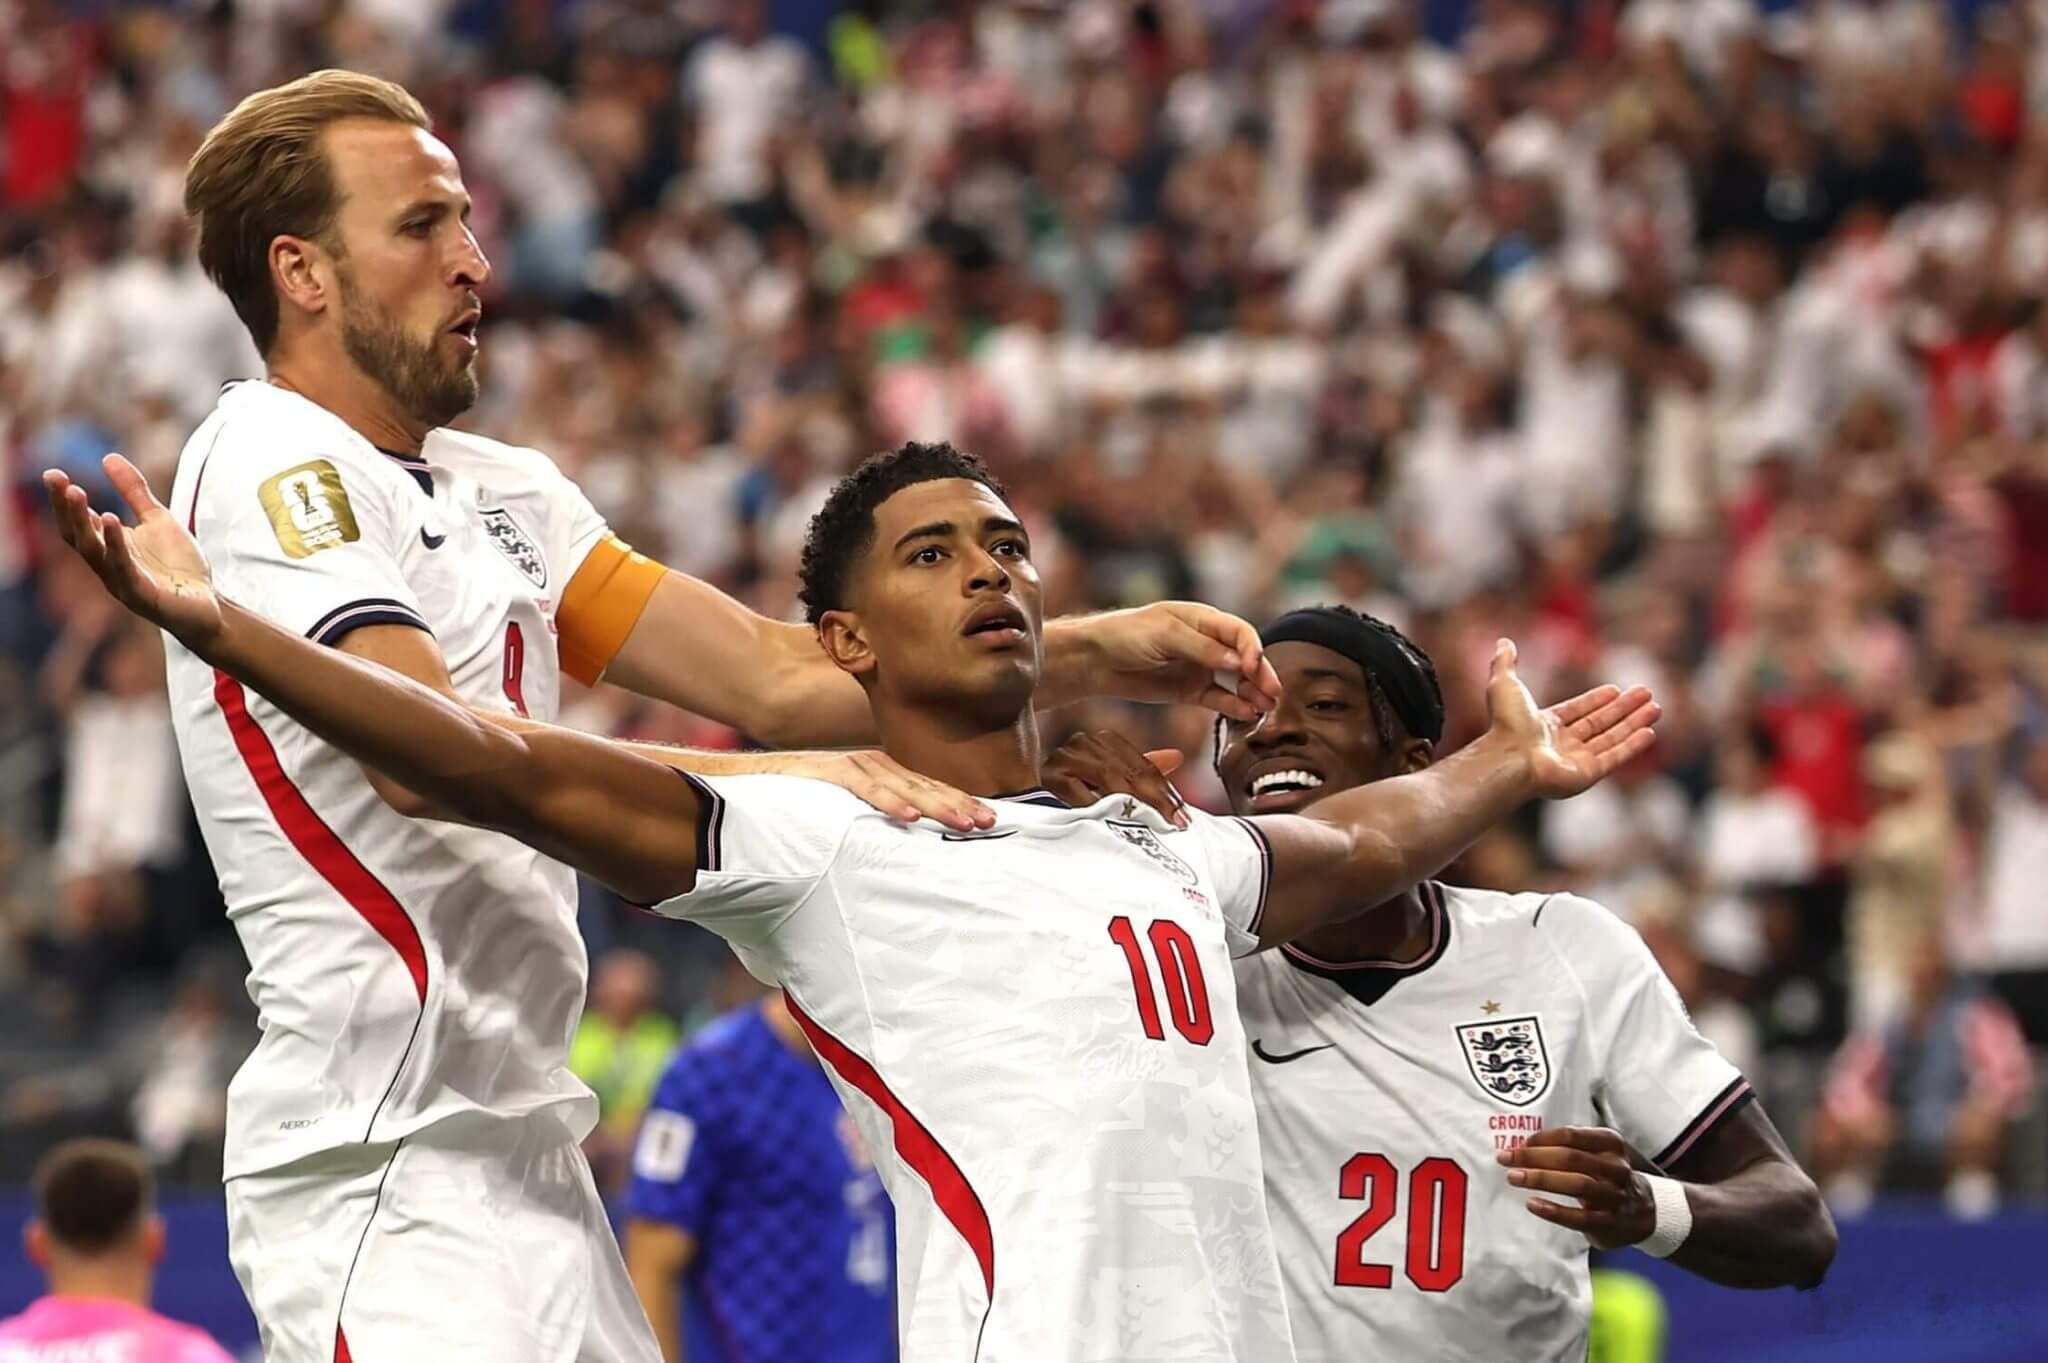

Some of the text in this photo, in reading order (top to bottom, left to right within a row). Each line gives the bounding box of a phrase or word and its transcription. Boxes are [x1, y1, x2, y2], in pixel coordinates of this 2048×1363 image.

[502, 620, 530, 719] 9
[1107, 915, 1215, 1046] 10
[1488, 1115, 1543, 1131] CROATIA
[1333, 1151, 1468, 1293] 20
